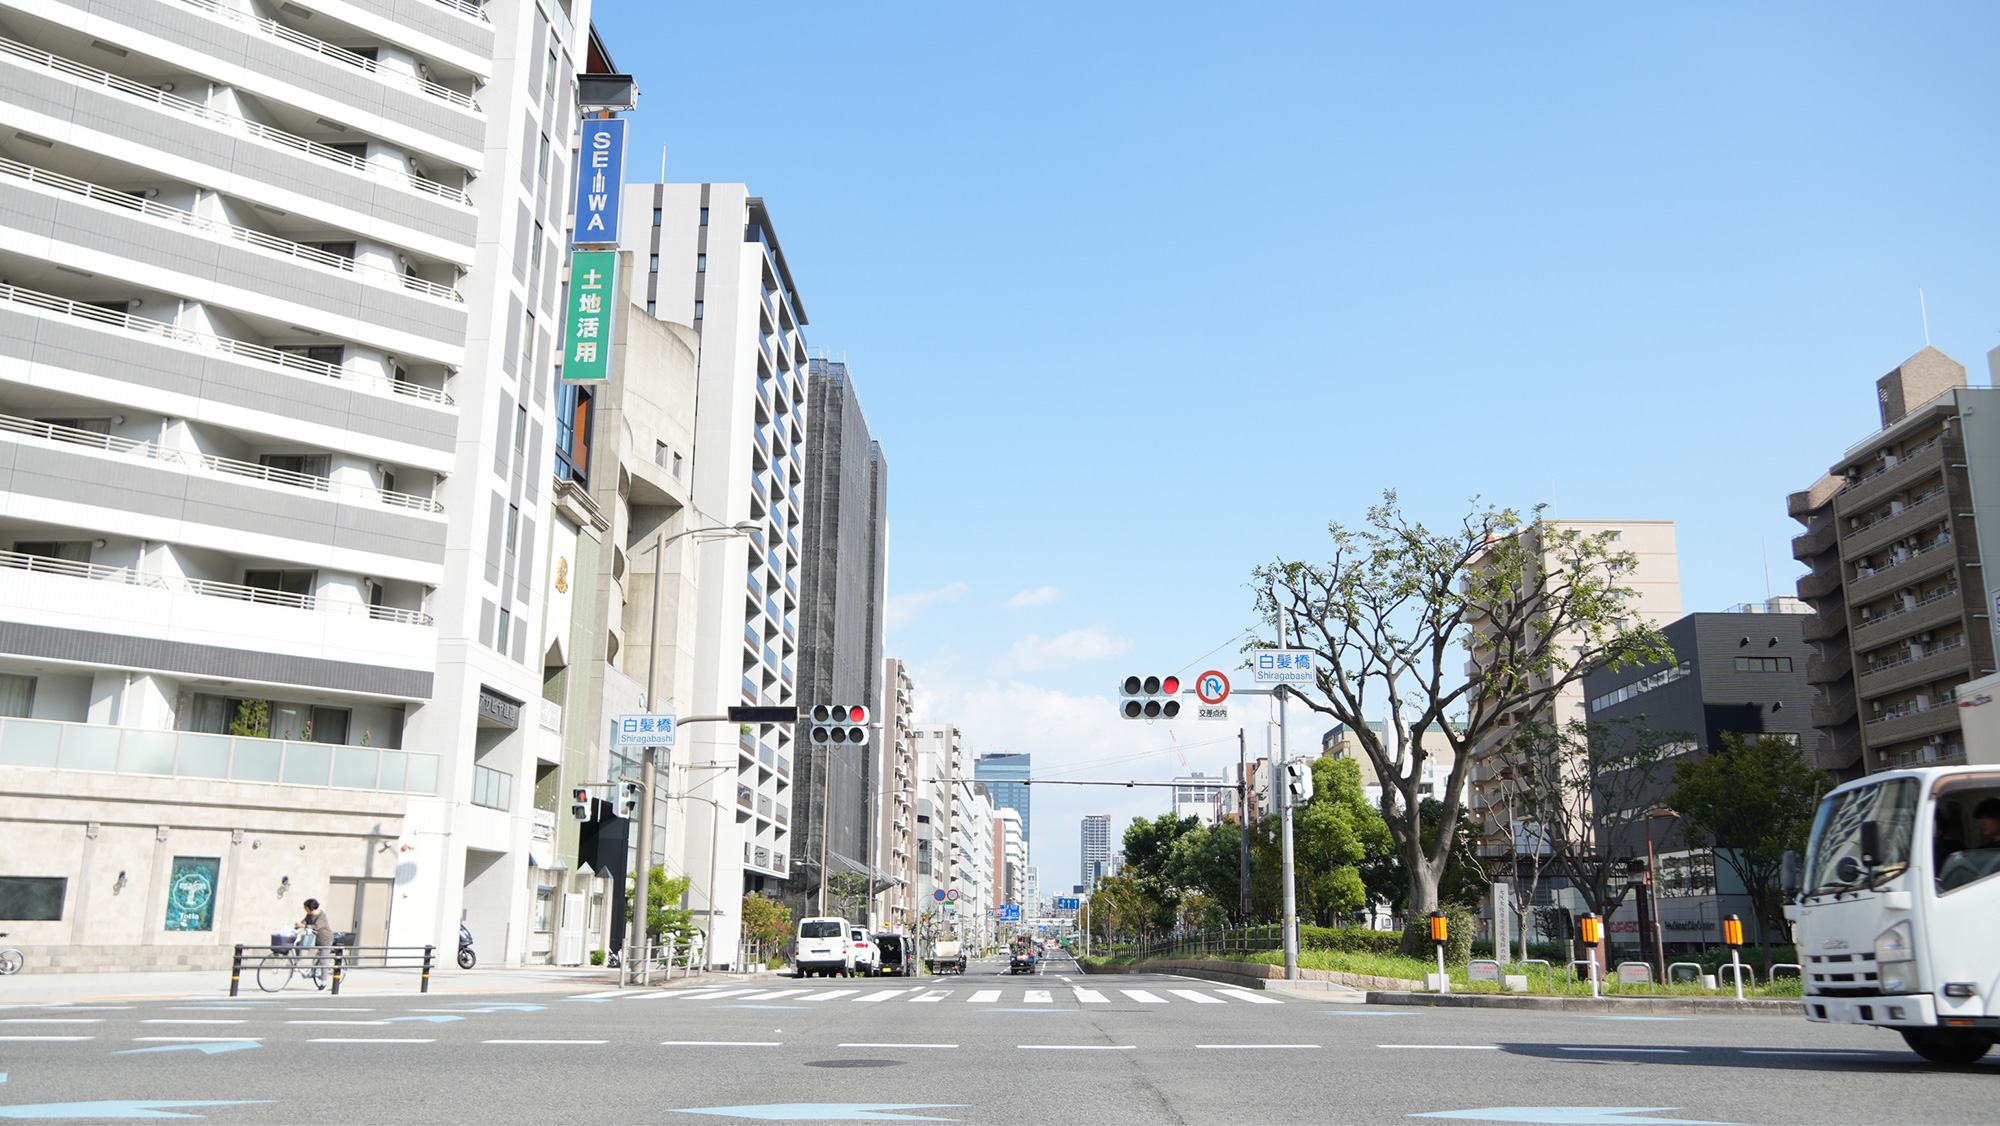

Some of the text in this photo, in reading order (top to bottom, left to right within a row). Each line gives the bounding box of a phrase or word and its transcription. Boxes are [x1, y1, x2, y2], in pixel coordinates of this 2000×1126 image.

[574, 269, 602, 363] 土地活用
[1259, 654, 1310, 669] 白髪橋
[1257, 670, 1313, 681] Shiragabashi
[1199, 708, 1227, 718] 交差点内
[624, 717, 671, 732] 白髪橋
[620, 733, 673, 744] Shiragabashi
